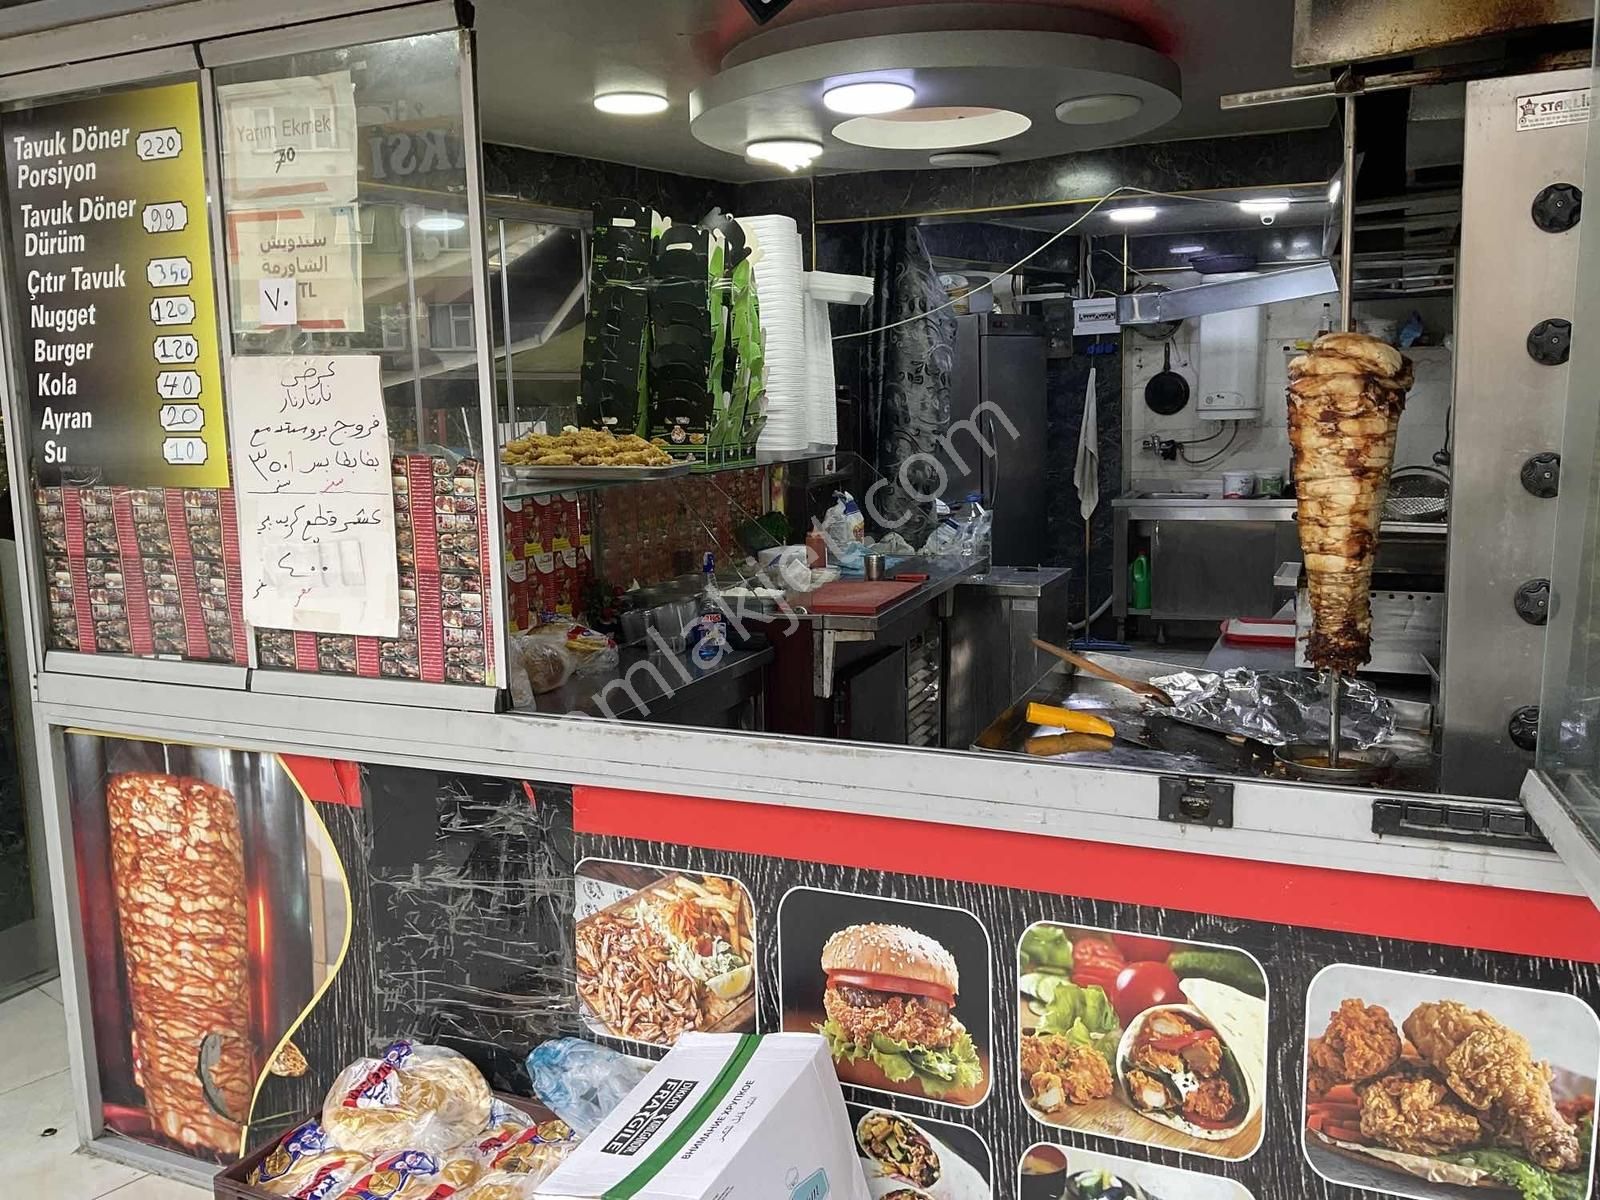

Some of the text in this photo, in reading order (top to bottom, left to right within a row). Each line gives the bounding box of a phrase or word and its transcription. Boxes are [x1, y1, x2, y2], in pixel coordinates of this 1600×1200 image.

[282, 114, 332, 137] Ekmek
[14, 126, 130, 161] Tavuk Döner
[144, 136, 175, 156] 220
[18, 160, 96, 189] Porsiyon
[20, 196, 137, 229] Tavuk Döner
[151, 208, 175, 232] 99
[25, 231, 85, 257] Dürüm
[27, 264, 126, 300] Çıtır Tavuk
[155, 264, 188, 285] 350
[298, 282, 317, 298] TL
[31, 304, 96, 333] Nugget
[155, 300, 188, 321] 120
[34, 339, 94, 366] Burger
[158, 339, 193, 360] 120
[38, 372, 77, 397] Kola
[163, 374, 193, 395] 40
[41, 407, 92, 435] Ayran
[167, 406, 198, 426] 20
[44, 440, 67, 464] Su
[170, 441, 194, 461] 10
[606, 1081, 677, 1153] FRAGILE
